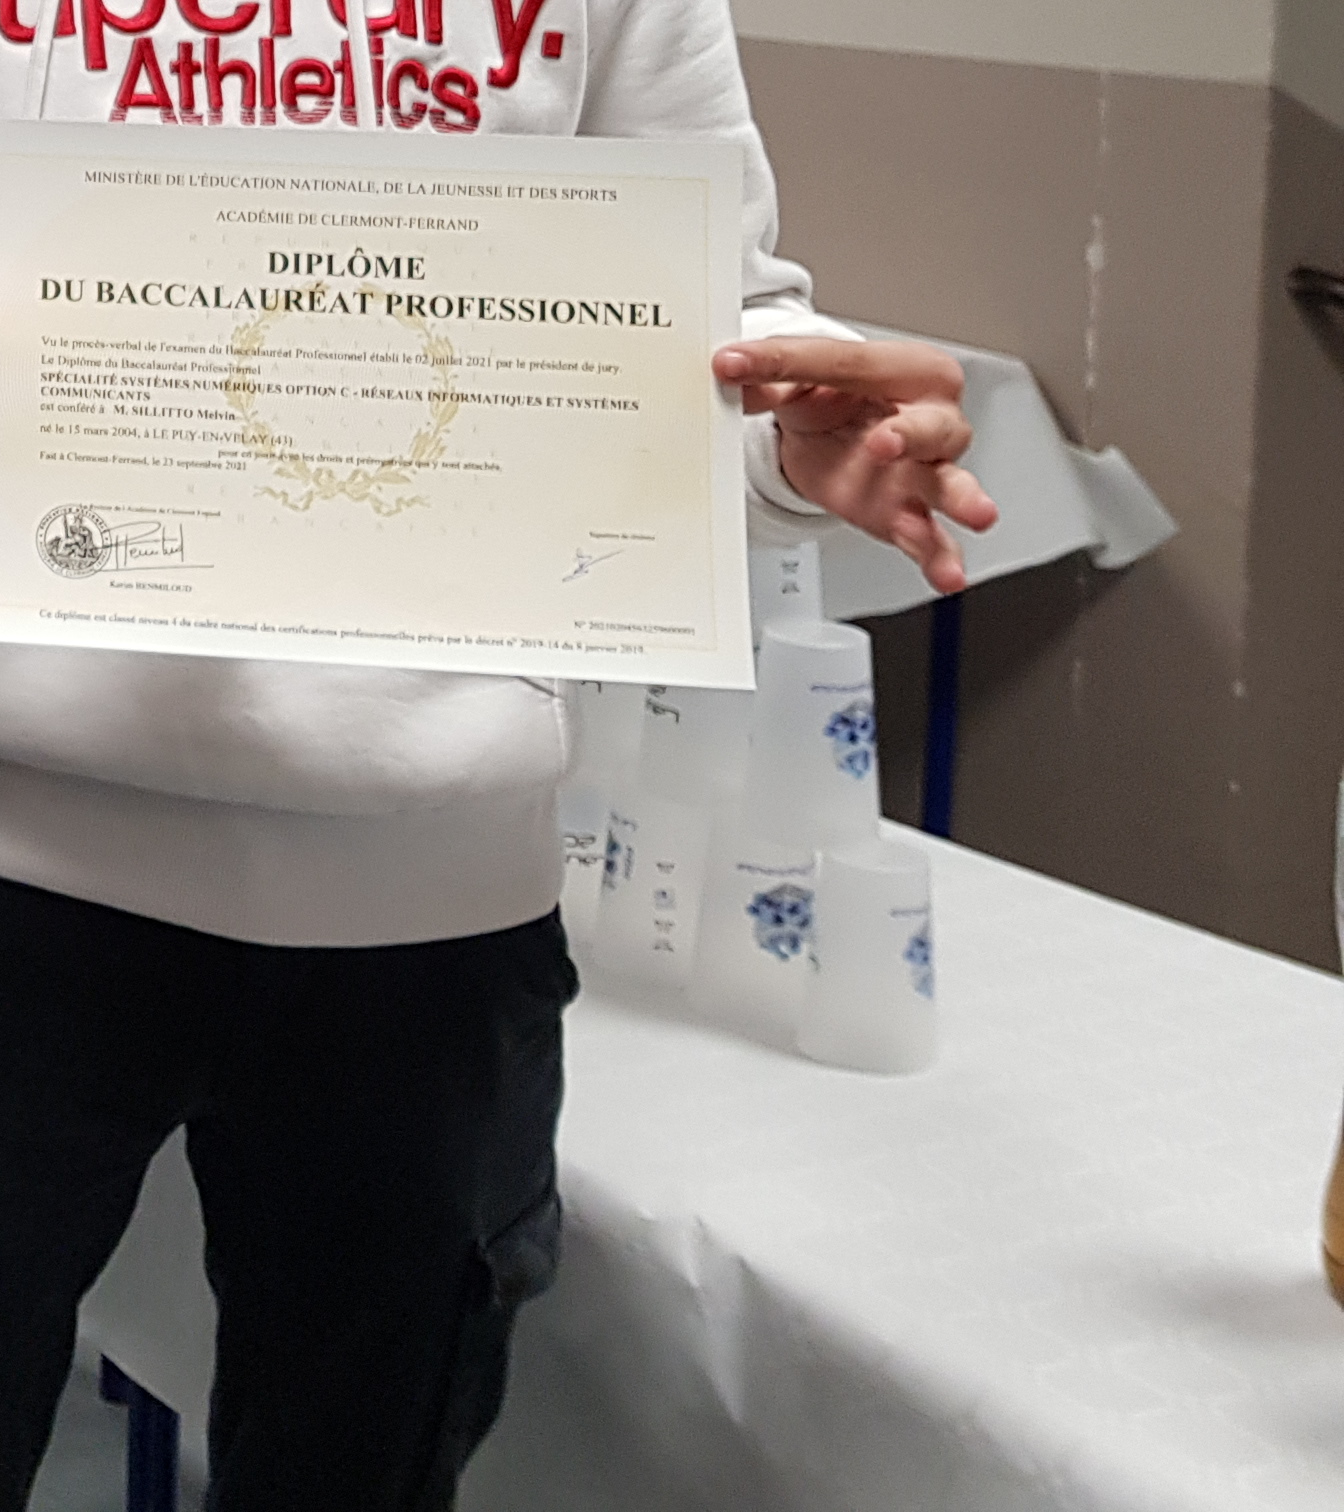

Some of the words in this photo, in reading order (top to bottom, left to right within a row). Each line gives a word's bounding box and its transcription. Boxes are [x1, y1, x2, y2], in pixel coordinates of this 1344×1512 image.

[83, 169, 163, 186] MINISTÈRE
[164, 173, 187, 187] DE
[187, 173, 288, 191] L'ÉDUCATION
[288, 177, 381, 195] NATIONALE,
[382, 180, 405, 195] DE
[405, 181, 428, 196] LA
[429, 182, 505, 199] JEUNESSE
[505, 185, 527, 200] ET
[527, 185, 559, 201] DES
[560, 187, 619, 203] SPORTS
[215, 208, 296, 225] ACADÉMIE
[296, 212, 320, 226] DE
[319, 213, 481, 232] CLERMONT-FERRAND
[268, 246, 426, 281] DIPLÔME
[40, 278, 84, 303] DU
[96, 280, 375, 315] BACCALAURÉAT
[385, 292, 673, 329] PROFESSIONNEL
